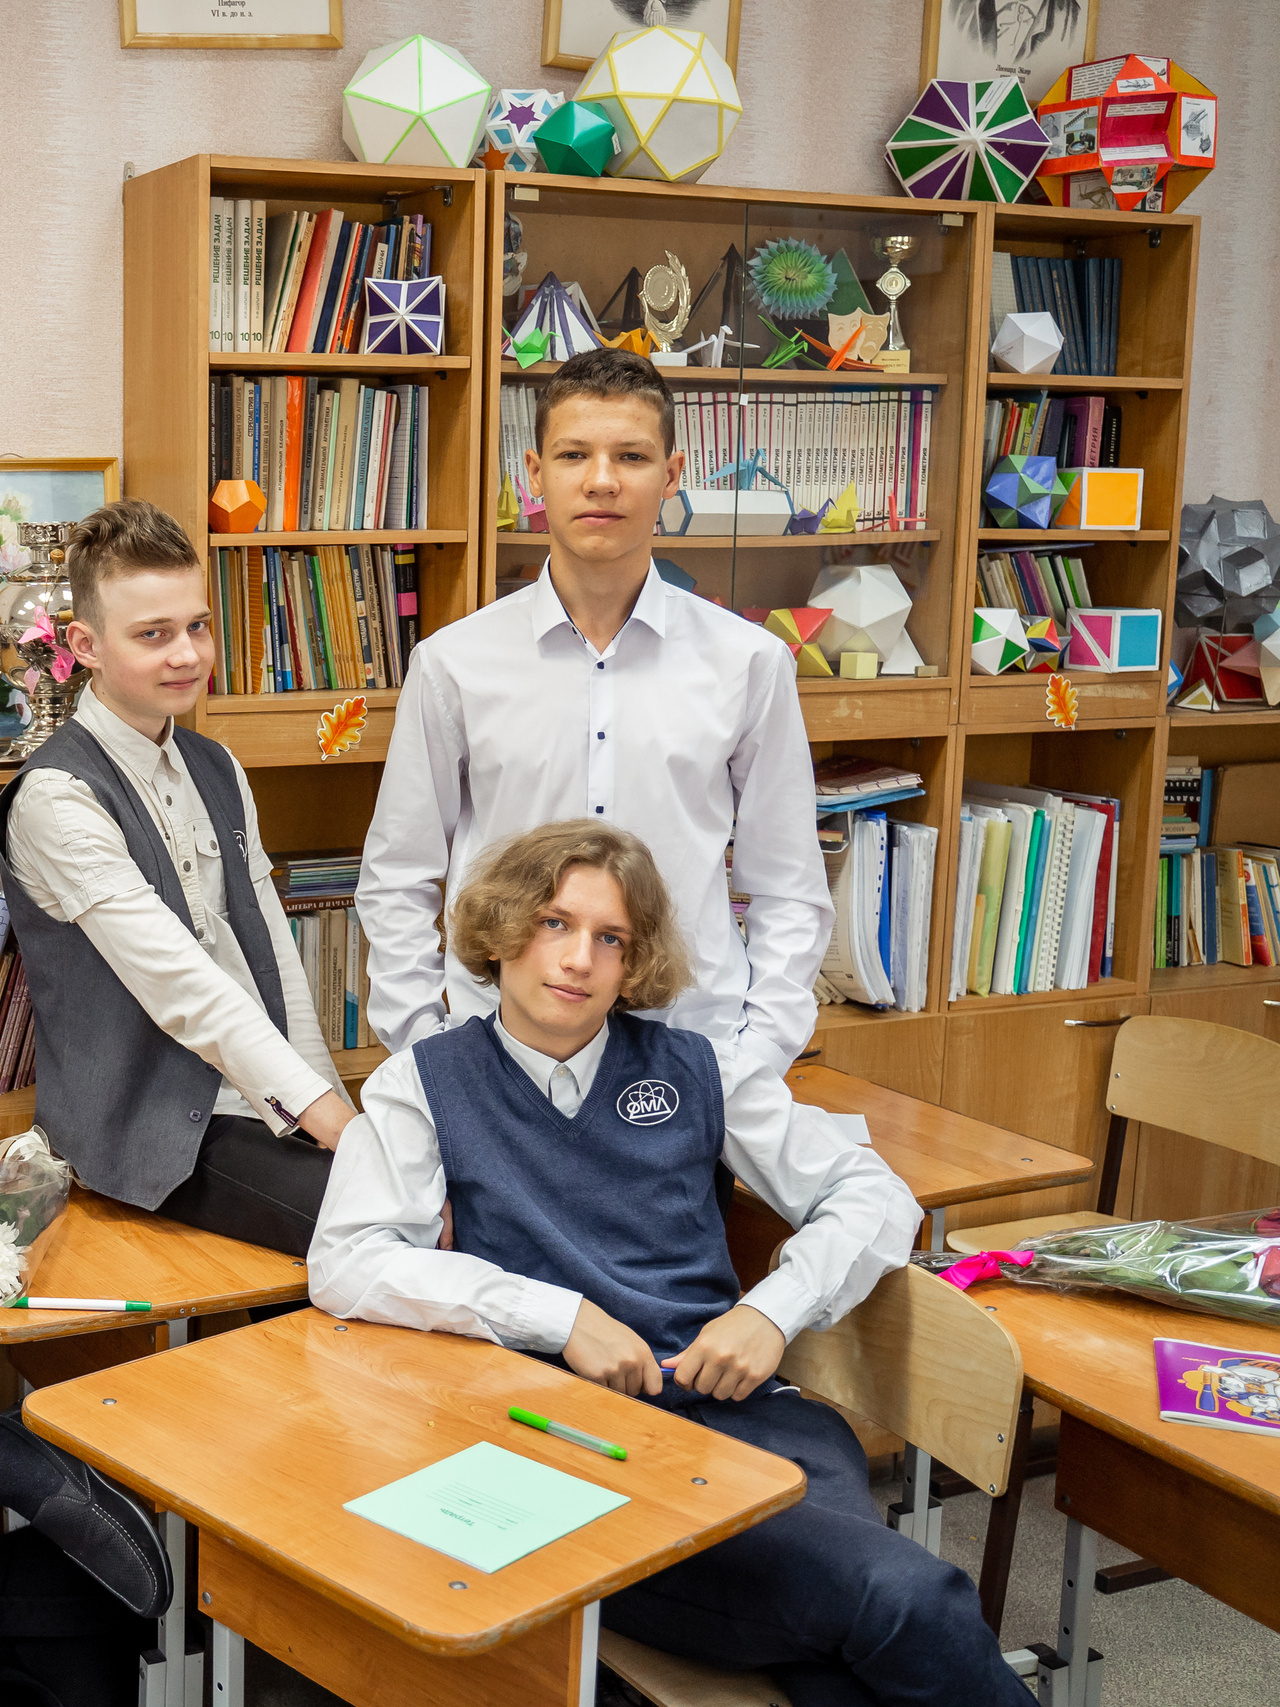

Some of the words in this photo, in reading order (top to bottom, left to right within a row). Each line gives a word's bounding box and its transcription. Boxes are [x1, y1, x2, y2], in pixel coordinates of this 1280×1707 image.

[210, 331, 220, 340] 10
[223, 332, 233, 341] 10
[240, 332, 250, 341] 10
[252, 332, 262, 341] 10
[236, 414, 242, 422] ПО
[358, 427, 369, 486] ЗАНИМАТЕЛЬНАЯ
[364, 396, 372, 426] АЛГЕБРА
[319, 446, 327, 490] ЗАНИМАТЕЛЬНОЙ
[353, 569, 362, 598] ГЕОМЕТРИЯ
[286, 903, 316, 911] АЛГЕБРА
[440, 1508, 475, 1527] Тетрадь
